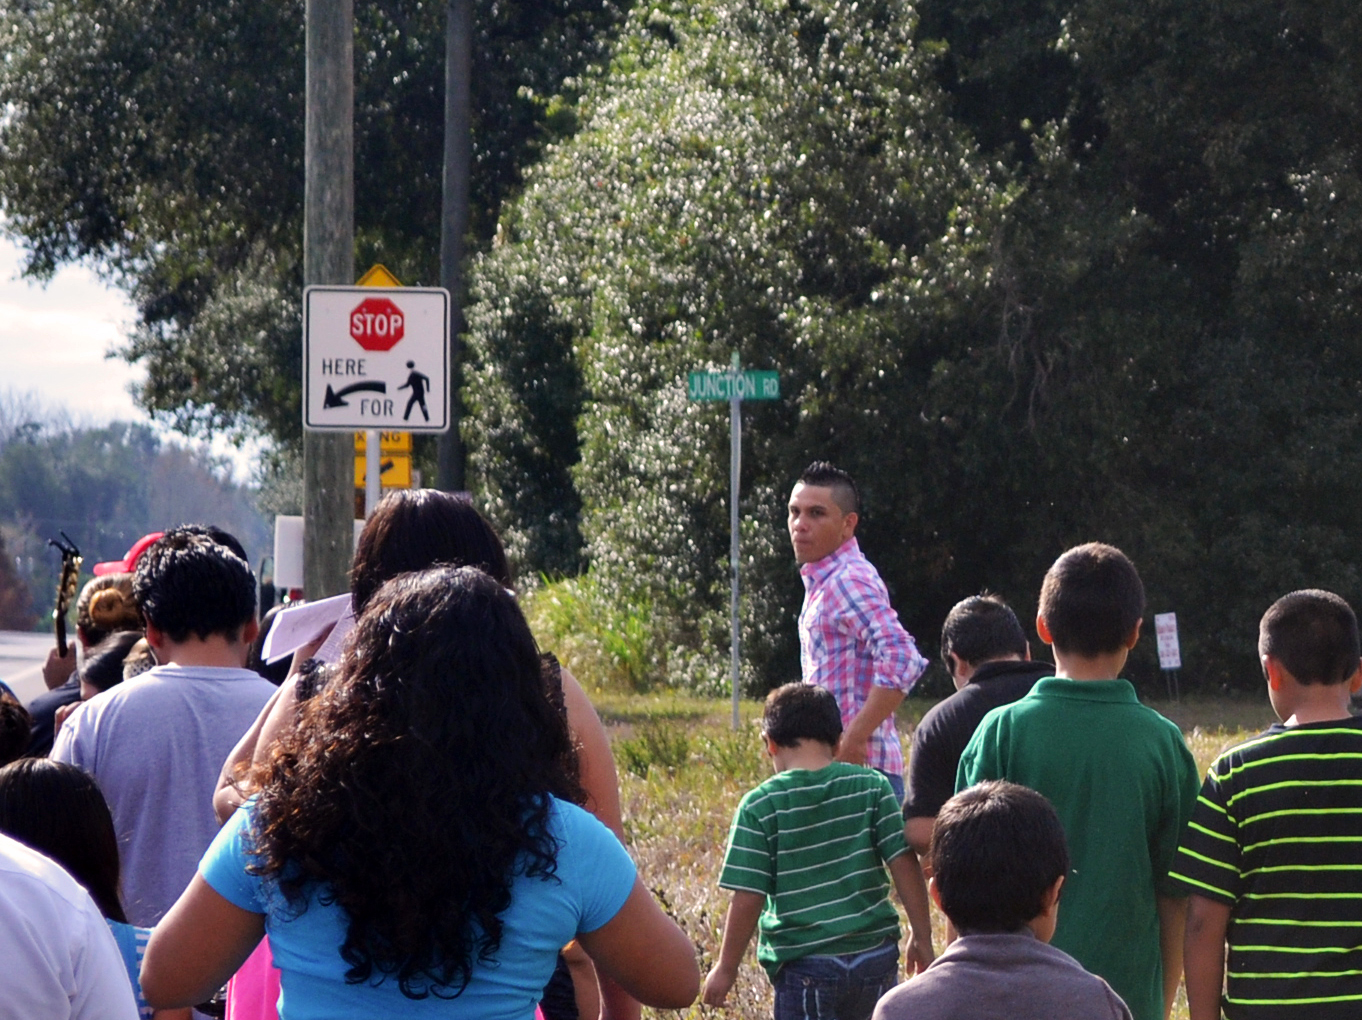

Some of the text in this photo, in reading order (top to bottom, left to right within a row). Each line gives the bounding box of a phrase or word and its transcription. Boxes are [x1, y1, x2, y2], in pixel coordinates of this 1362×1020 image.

[352, 313, 402, 336] STOP
[322, 358, 366, 375] HERE
[690, 374, 778, 398] JUNCTION RD
[360, 398, 393, 416] FOR
[356, 430, 401, 442] XNG
